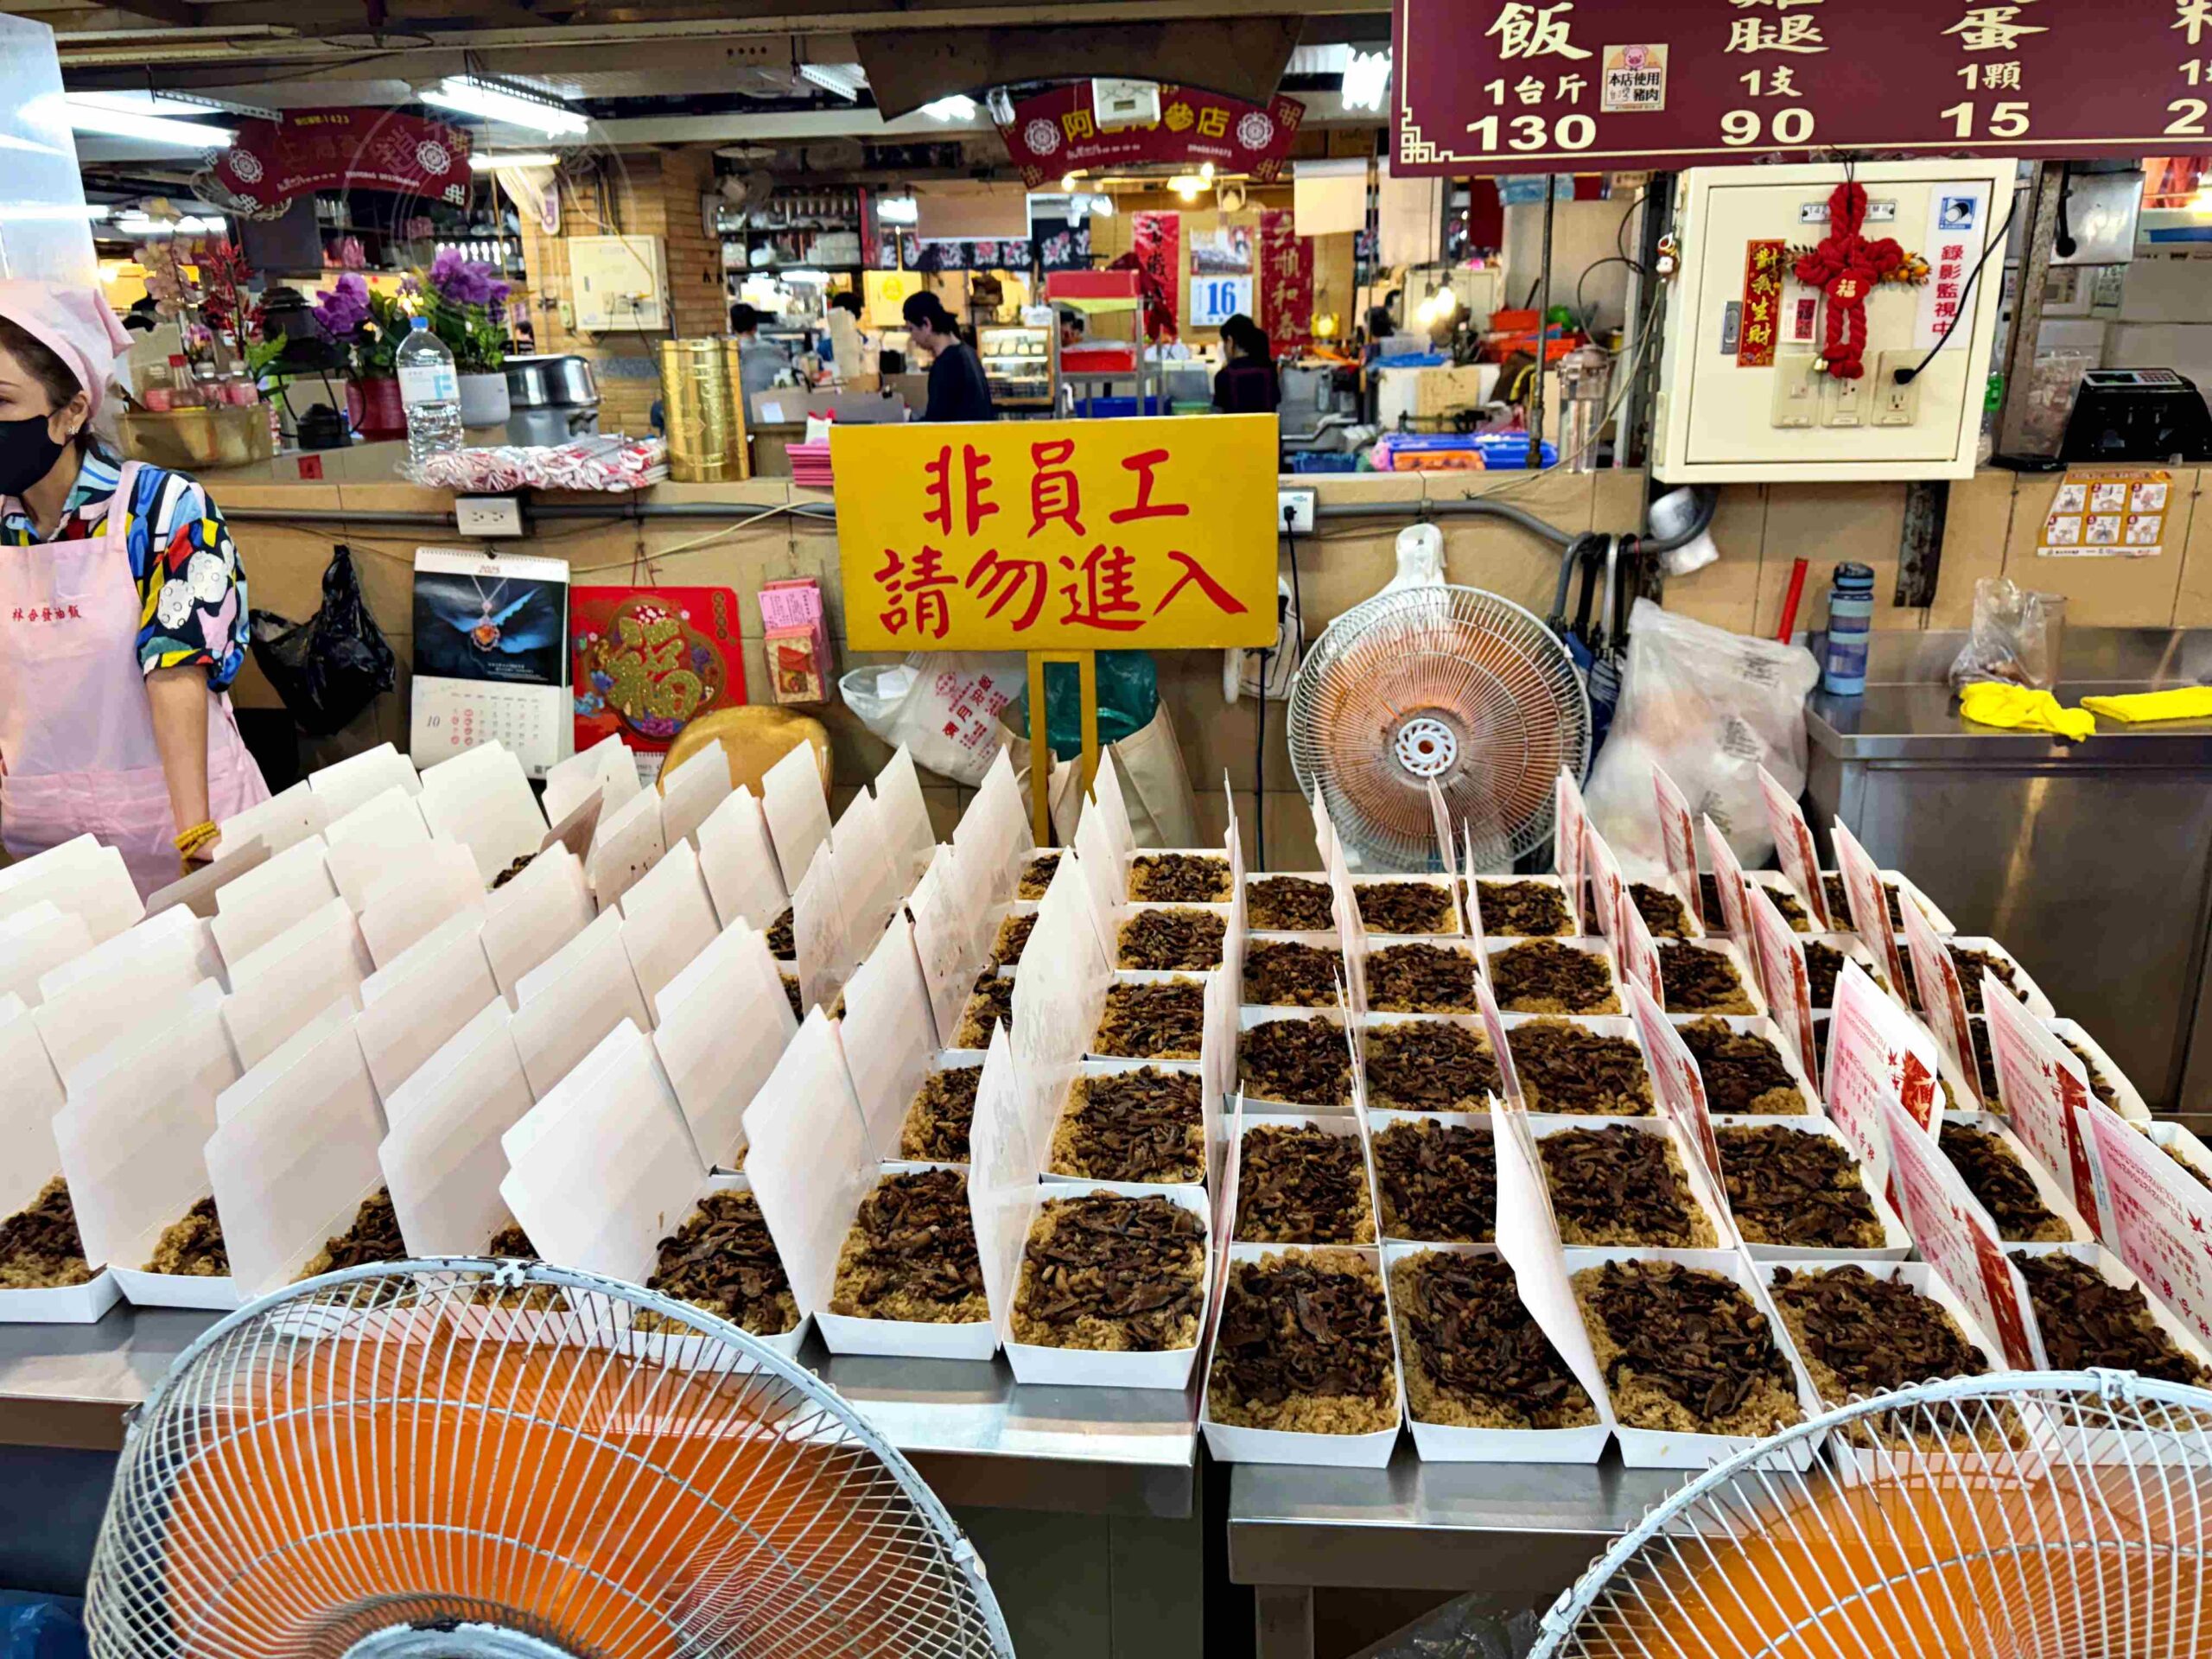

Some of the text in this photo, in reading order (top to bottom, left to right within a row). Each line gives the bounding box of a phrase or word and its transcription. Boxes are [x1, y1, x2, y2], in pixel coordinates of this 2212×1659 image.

[1484, 2, 1593, 60] 飯
[1723, 0, 1830, 54] 腿
[1940, 0, 2050, 50] 蛋
[1484, 74, 1588, 105] 1台斤
[1609, 73, 1660, 86] 本店使用
[1739, 66, 1803, 97] 1支
[1957, 61, 2021, 90] 1顆
[2178, 59, 2212, 86] 1
[1466, 114, 1597, 151] 130
[1720, 107, 1815, 145] 90
[1941, 102, 2030, 137] 15
[1207, 282, 1236, 315] 16
[1746, 247, 1780, 345] 對我生財
[1835, 278, 1857, 298] 福
[1932, 245, 1964, 336] 錄影監視中
[923, 438, 1191, 538] 非員工
[873, 543, 1250, 639] 請勿進入
